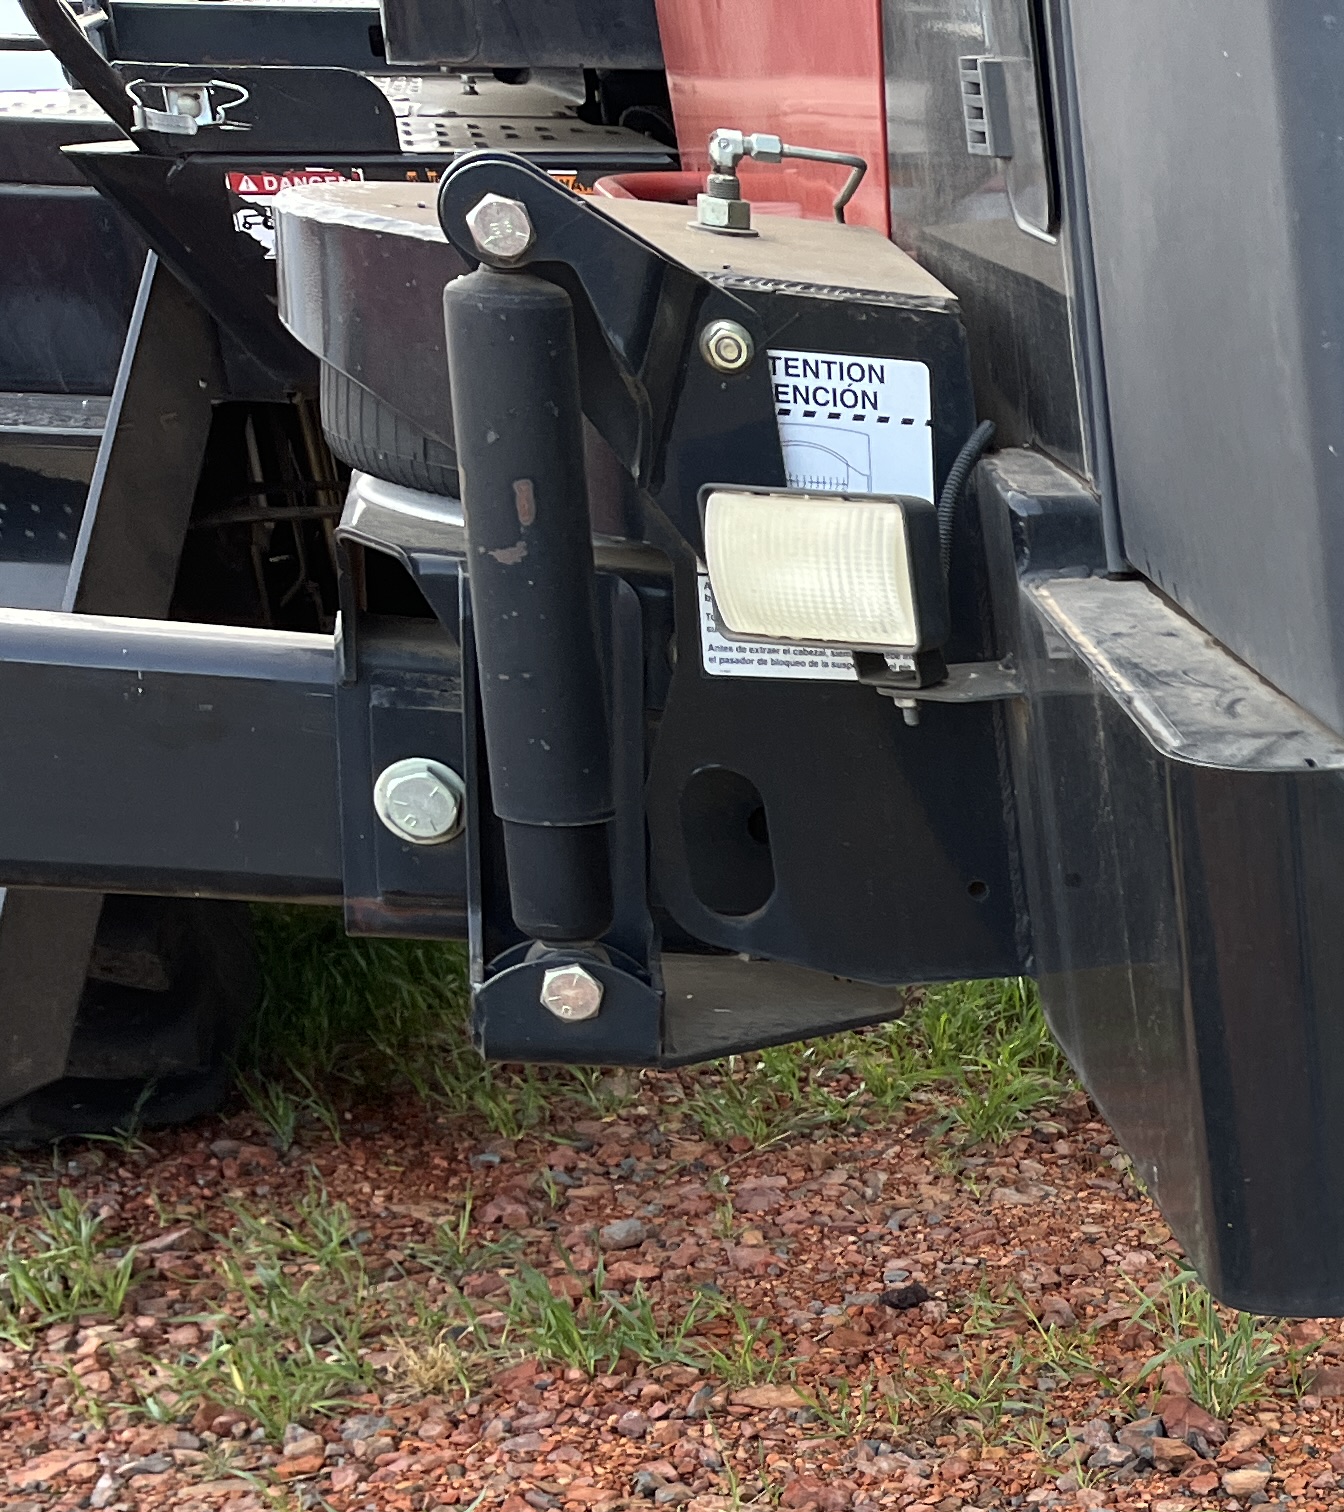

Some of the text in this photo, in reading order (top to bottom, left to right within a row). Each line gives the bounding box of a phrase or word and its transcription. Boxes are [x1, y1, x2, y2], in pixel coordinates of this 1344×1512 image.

[768, 356, 885, 384] TENTION
[774, 383, 878, 411] ENCIÓN
[708, 644, 734, 653] Antes
[735, 646, 748, 654] de
[708, 656, 717, 664] el
[719, 657, 755, 666] pasador
[757, 658, 768, 666] de
[770, 658, 807, 668] bloqueo
[808, 660, 819, 668] de
[821, 660, 830, 668] la
